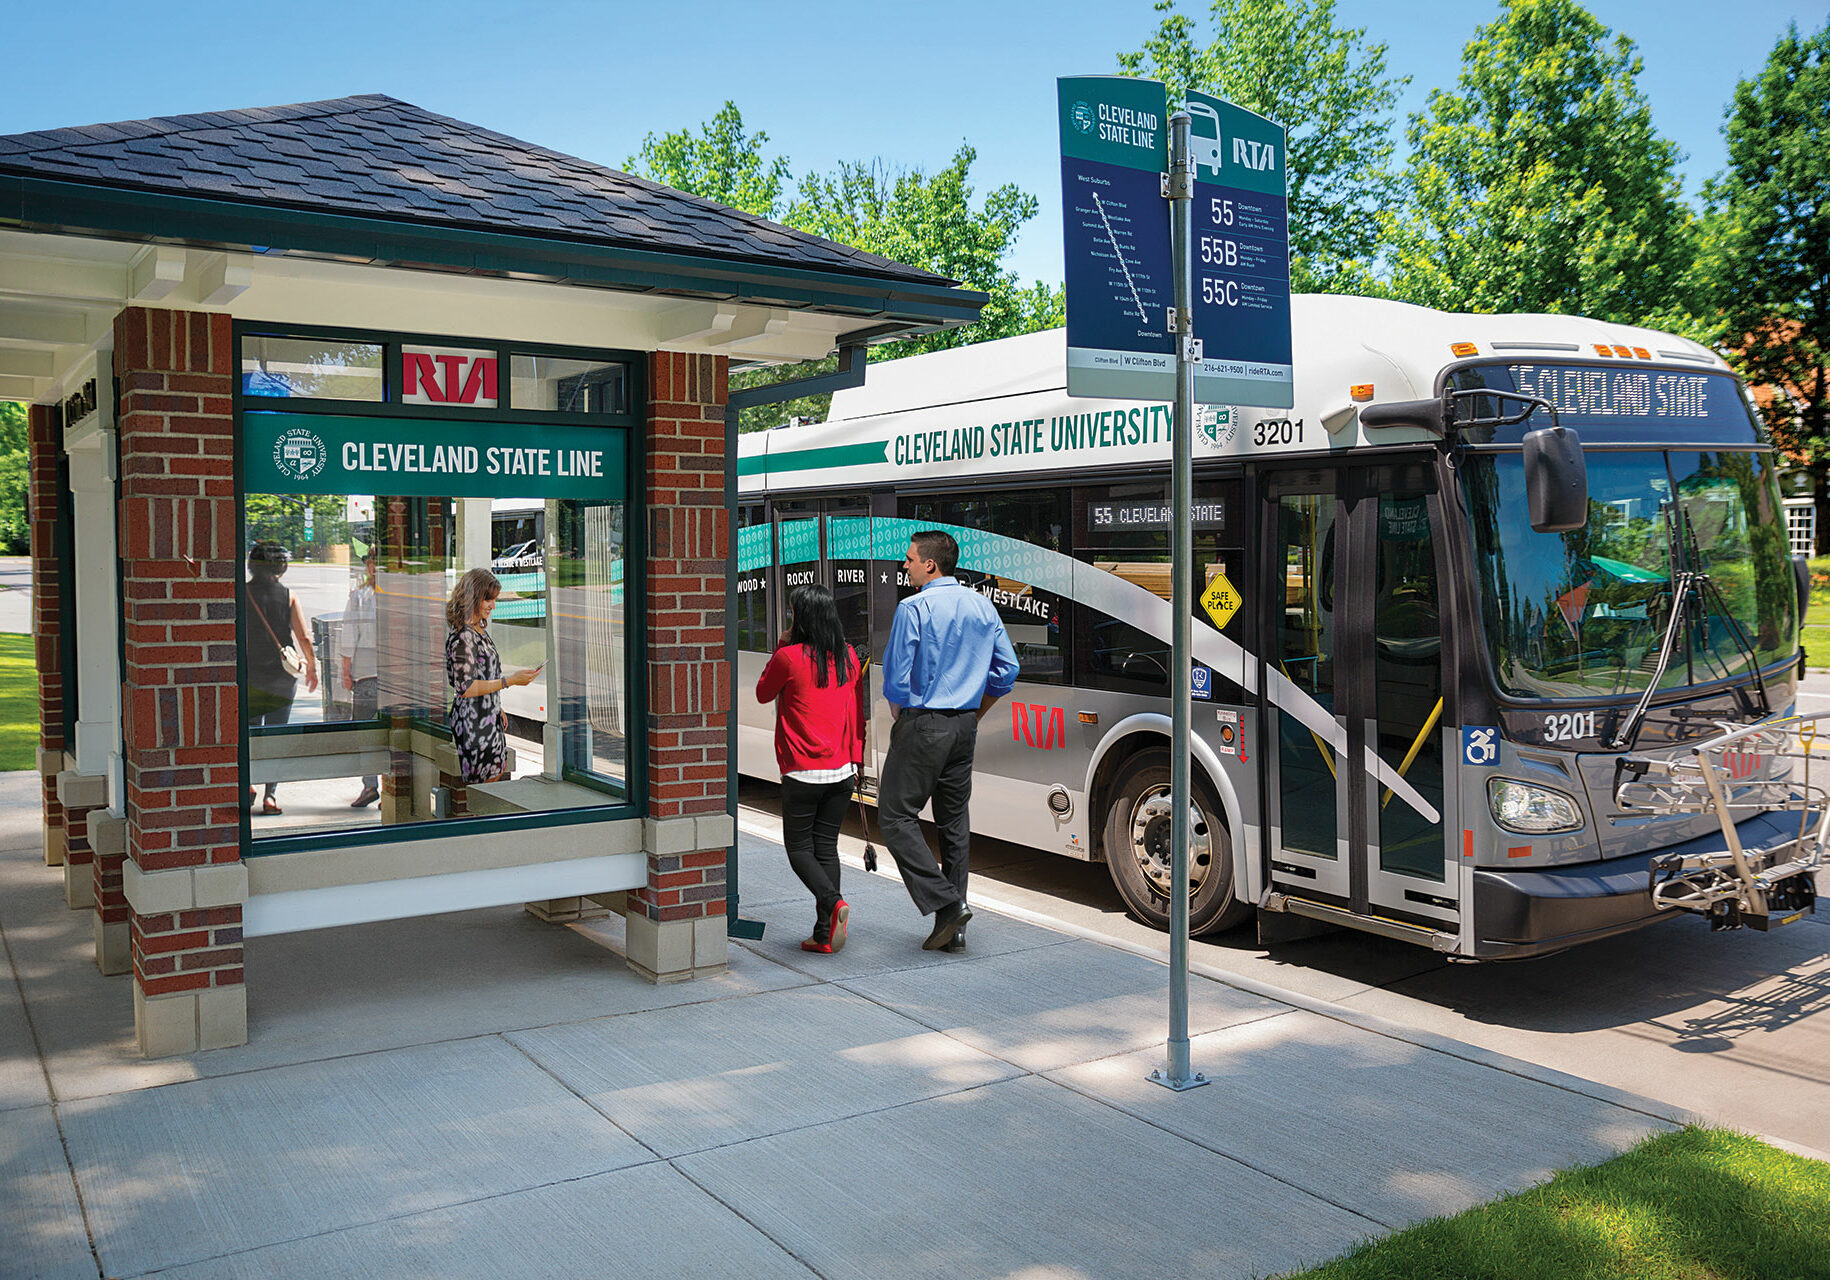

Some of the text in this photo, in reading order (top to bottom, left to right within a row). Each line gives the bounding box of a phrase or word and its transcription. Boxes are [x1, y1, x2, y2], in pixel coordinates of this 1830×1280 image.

[1098, 103, 1158, 131] CLEVELAND
[1099, 123, 1155, 150] STATE LINE
[1233, 137, 1275, 171] RTA
[1077, 174, 1111, 186] West Suburbs
[1211, 198, 1234, 226] 55
[1238, 202, 1263, 213] Downtown
[1239, 215, 1252, 223] Monday
[1254, 217, 1269, 225] Saturday
[1201, 236, 1238, 267] 55B
[1239, 242, 1264, 253] Downtown
[1202, 278, 1239, 306] 55C
[1240, 282, 1266, 292] Downtown
[1137, 329, 1163, 339] Downtown
[1094, 356, 1166, 368] Clifton Blvd W Clifton Blvd
[1203, 363, 1284, 378] 216-621-9500 rideRTA.com
[402, 352, 498, 404] RTA
[1538, 369, 1650, 416] CLEVELAND
[1655, 375, 1708, 417] STATE
[286, 428, 312, 438] STATE
[894, 404, 1175, 467] CLEVELAND STATE UNIVERSITY
[1253, 418, 1304, 447] 3201
[273, 434, 291, 477] CLEVELAND
[311, 434, 327, 477] UNIVERSITY
[342, 441, 604, 478] CLEVELAND STATE LINE
[1094, 506, 1113, 524] 55
[1119, 506, 1174, 523] CLEVELAN
[787, 570, 814, 586] ROCKY
[837, 569, 865, 583] RIVER
[896, 571, 912, 587] BA
[983, 584, 1050, 619] WESTLAKE
[1211, 591, 1229, 601] SAFE
[1011, 701, 1066, 750] RTA
[1543, 711, 1594, 742] 3201
